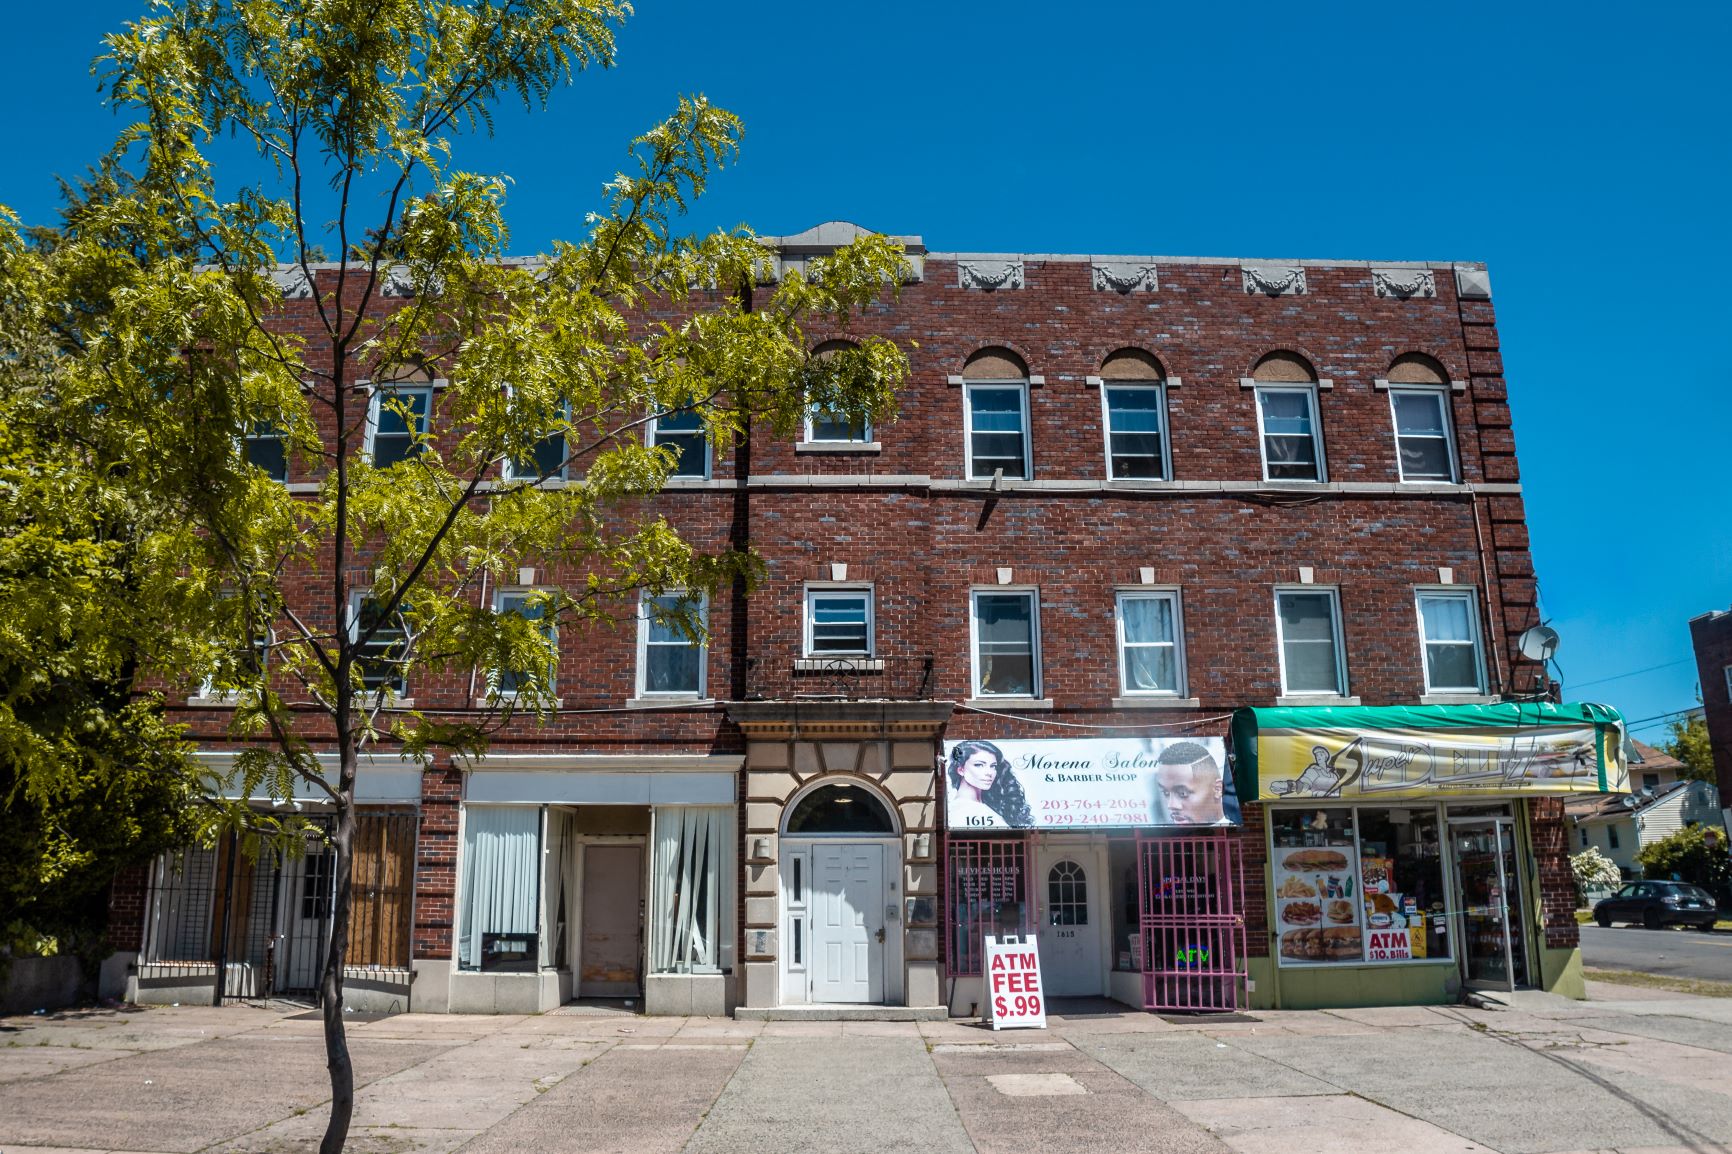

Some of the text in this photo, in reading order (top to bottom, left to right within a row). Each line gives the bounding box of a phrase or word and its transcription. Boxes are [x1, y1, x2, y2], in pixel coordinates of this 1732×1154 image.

[1013, 751, 1160, 772] Morena Salon
[1325, 737, 1421, 797] Super
[1045, 773, 1137, 783] & BARBER SHOP
[1041, 799, 1147, 810] 203-764-2064
[965, 815, 994, 826] 1615
[1044, 813, 1149, 824] 929-240-7981
[1369, 932, 1408, 949] ATM
[991, 953, 1037, 971] ATM
[1369, 949, 1409, 960] $10. Bills
[992, 972, 1039, 994] FEE
[995, 995, 1041, 1019] $.99
